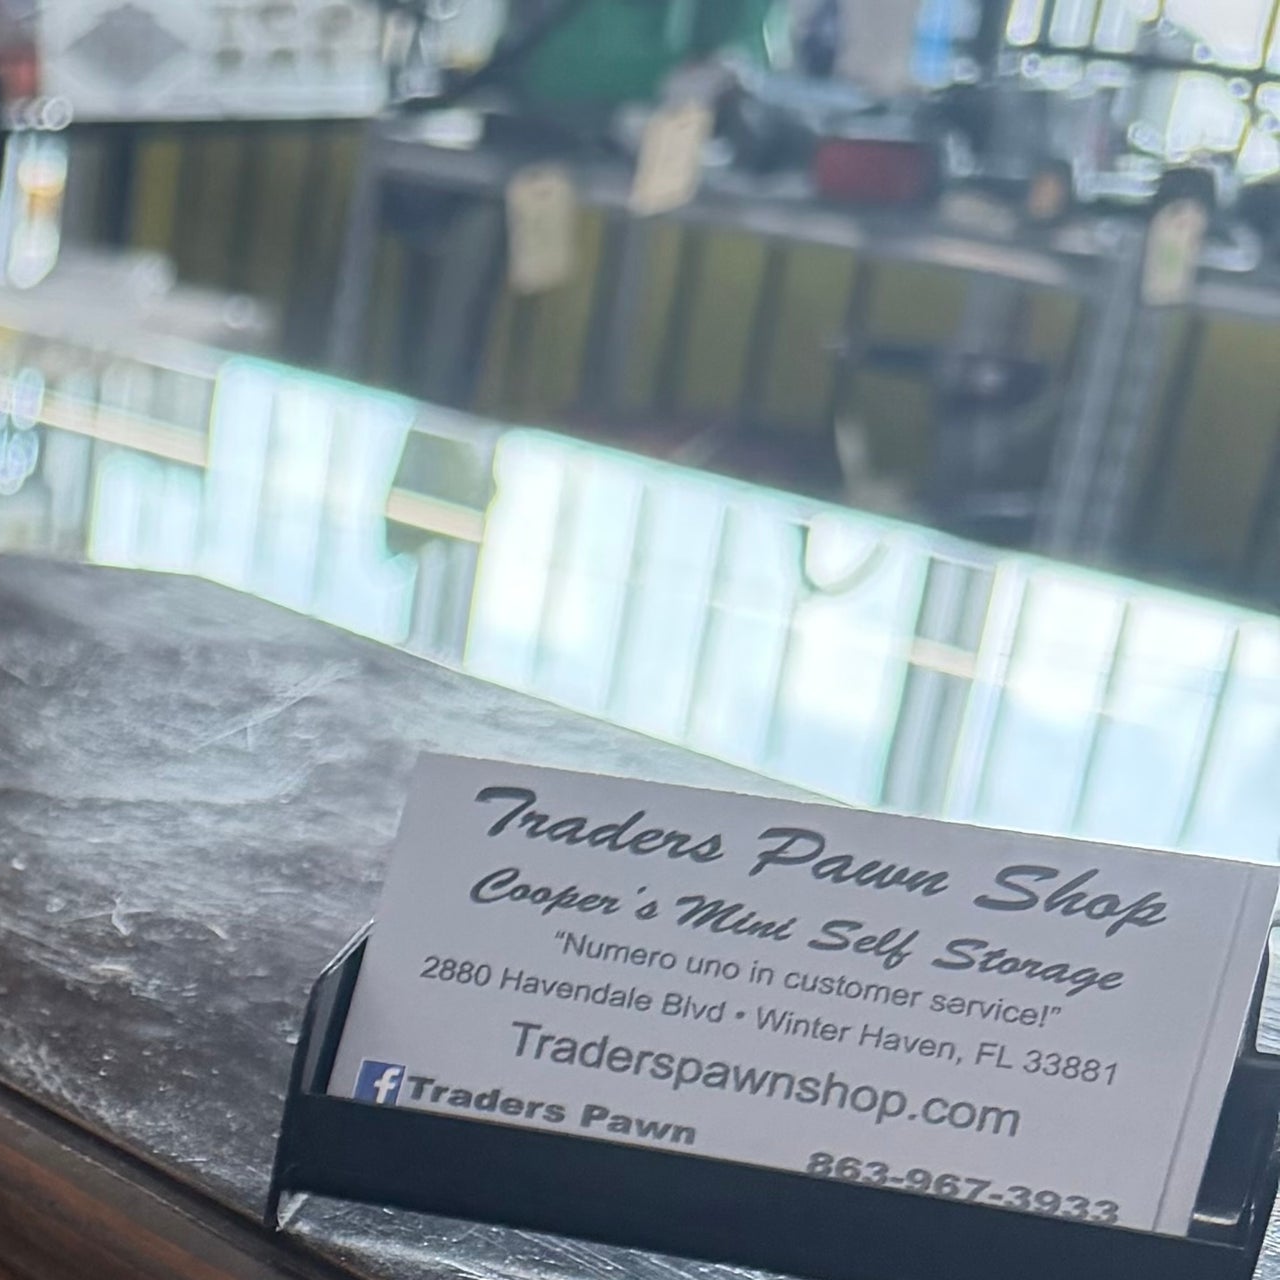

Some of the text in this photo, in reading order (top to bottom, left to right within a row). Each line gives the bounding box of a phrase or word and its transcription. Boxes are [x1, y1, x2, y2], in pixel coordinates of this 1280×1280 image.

[475, 786, 1167, 938] Traders Pawn Shop
[469, 867, 1125, 997] Cooper's Mini Self Storage
[687, 953, 740, 981] uno
[749, 961, 775, 986] in
[784, 969, 923, 1008] customer
[420, 957, 1119, 1086] 2880 Havendale Blvd Winter Haven, FL 33881
[511, 1020, 1021, 1138] Traderspawnshop.com
[406, 1075, 566, 1124] Traders
[579, 1103, 696, 1146] Pawn
[806, 1151, 1119, 1225] 863-967-3933
